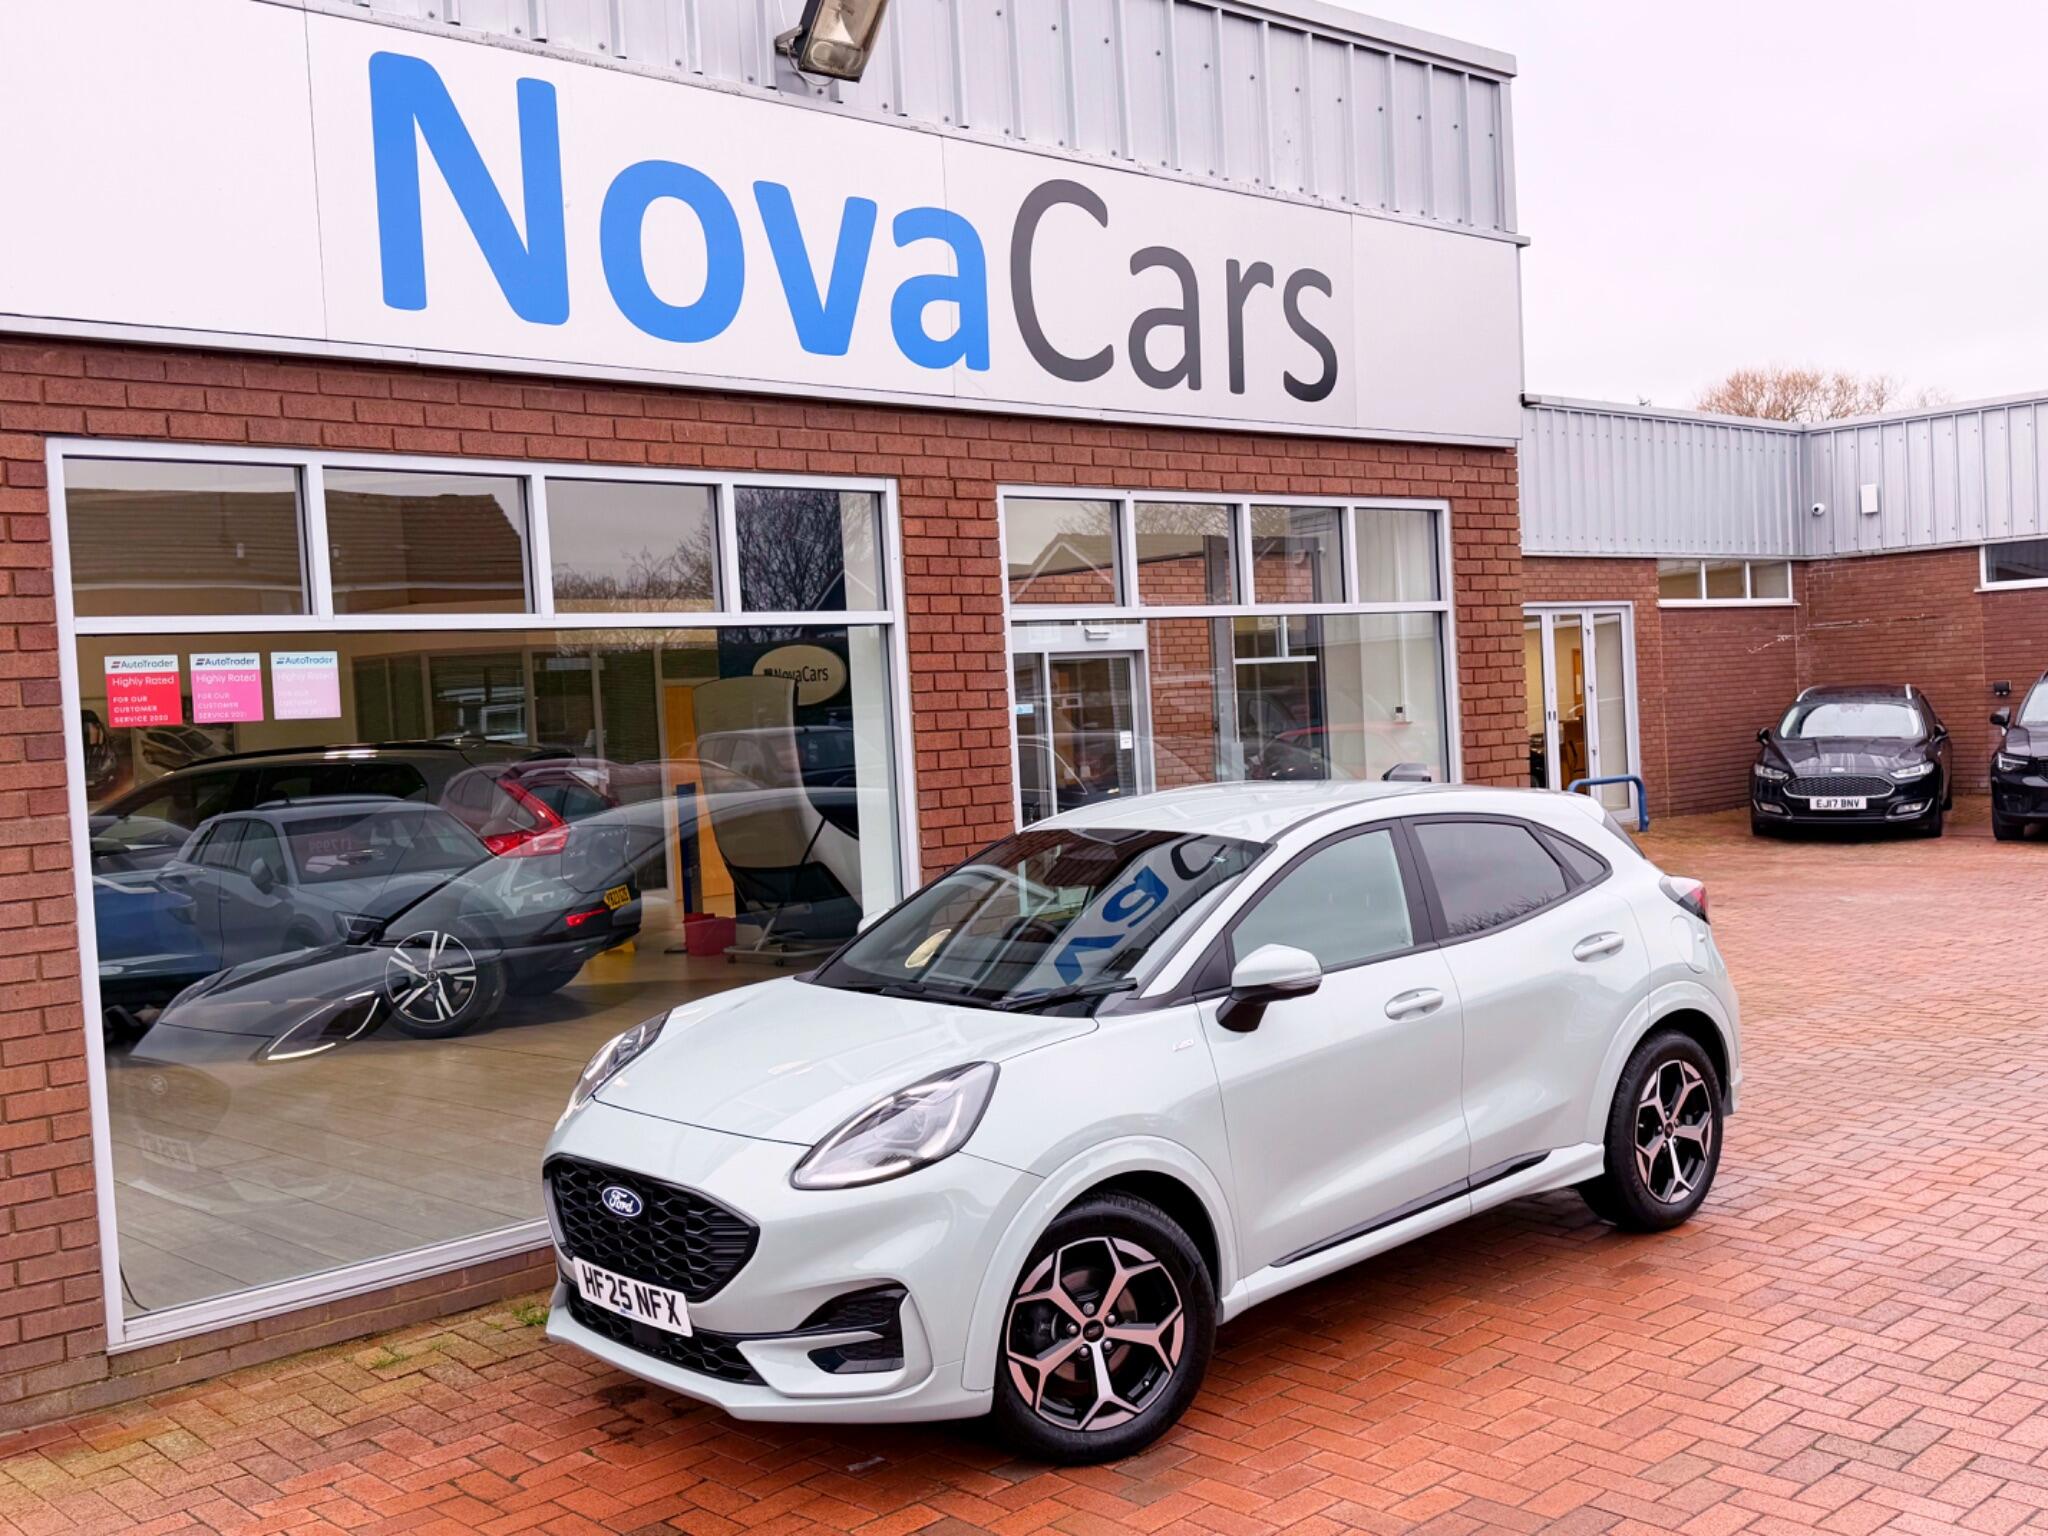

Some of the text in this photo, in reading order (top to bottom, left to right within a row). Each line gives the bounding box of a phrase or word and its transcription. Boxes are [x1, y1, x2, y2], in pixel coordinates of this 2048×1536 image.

[368, 50, 1339, 402] NovaCars
[121, 659, 174, 669] AutoTrader
[205, 656, 256, 666] AutoTrader
[285, 656, 334, 665] AutoTrader
[112, 674, 175, 688] Highly Rated
[227, 673, 257, 682] Rated
[113, 705, 158, 713] CUSTOMER
[114, 714, 148, 723] SERVICE
[1816, 798, 1860, 808] EJ17 BNV
[608, 1188, 634, 1213] Ford
[581, 1263, 682, 1328] HF25 NFX
